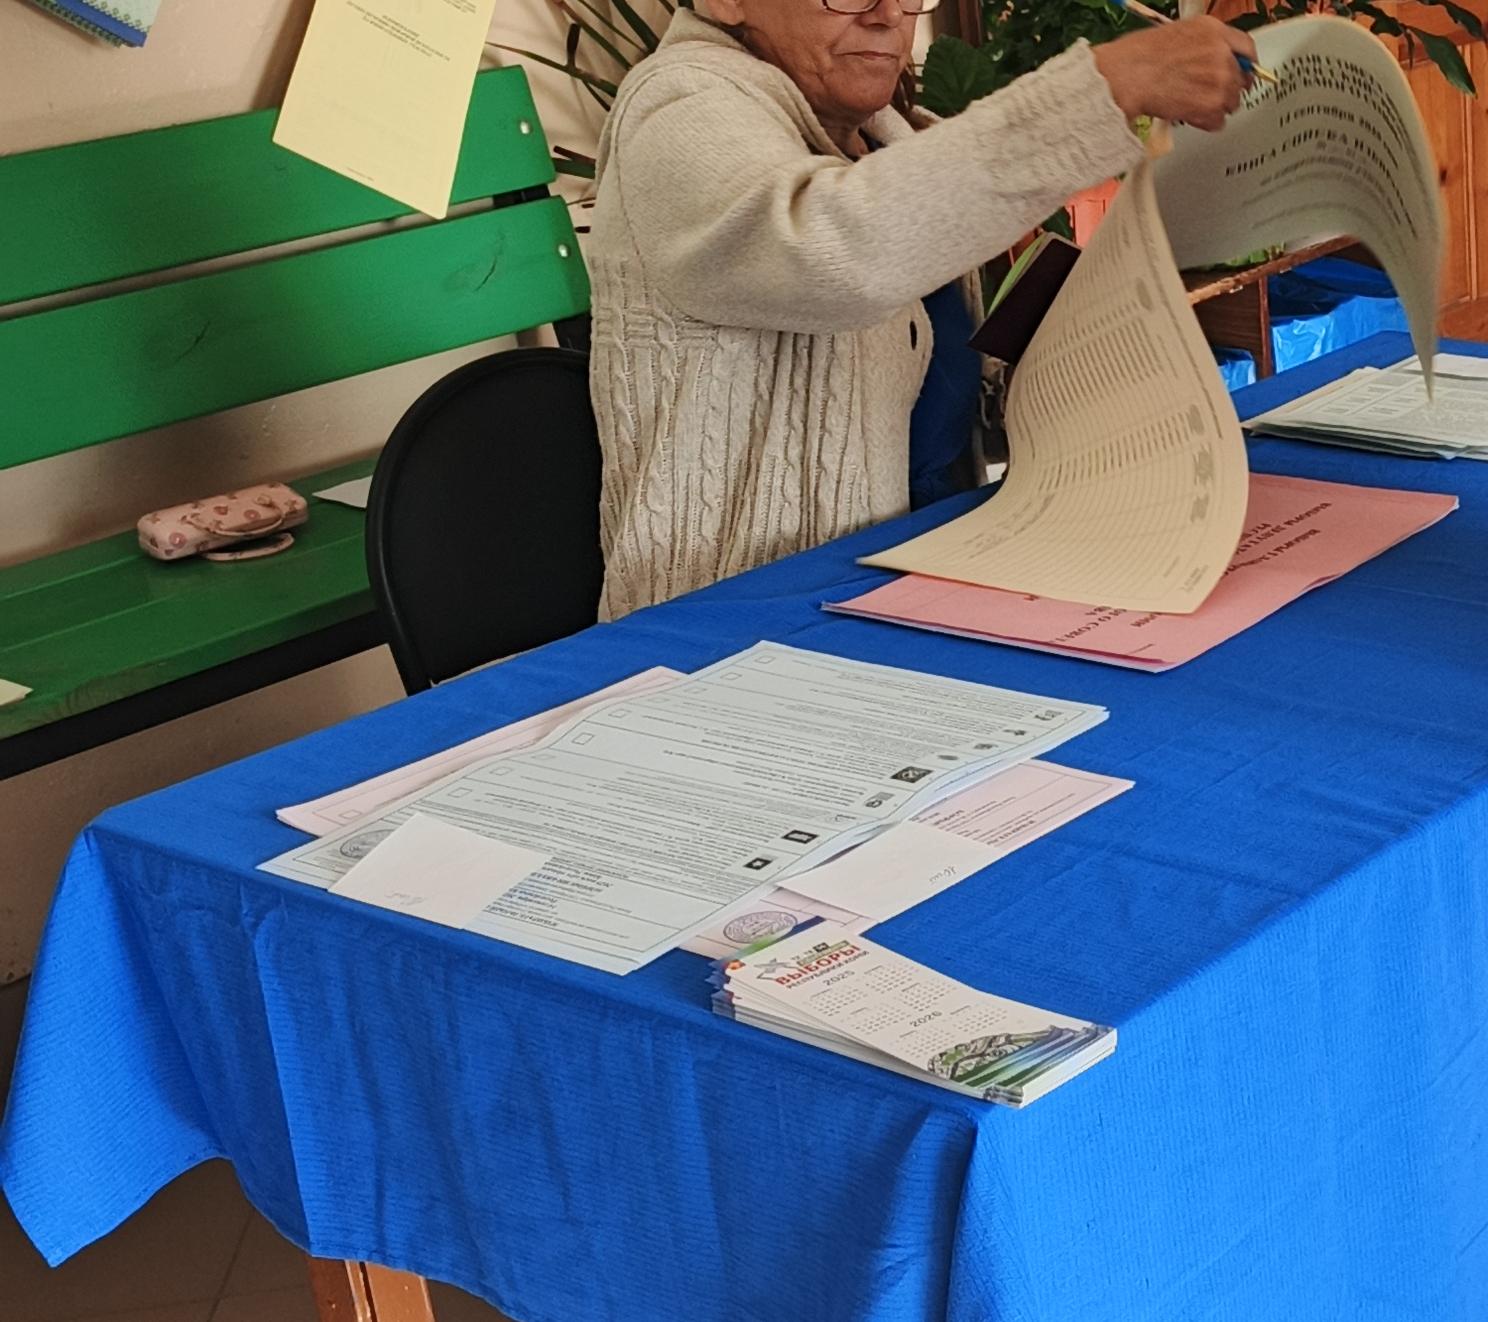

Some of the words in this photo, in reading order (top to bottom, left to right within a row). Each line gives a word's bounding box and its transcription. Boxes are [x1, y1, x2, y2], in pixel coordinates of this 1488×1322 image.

[775, 944, 862, 985] ВЫБОРЫ
[823, 970, 855, 986] 2025
[909, 1010, 943, 1028] 2026
